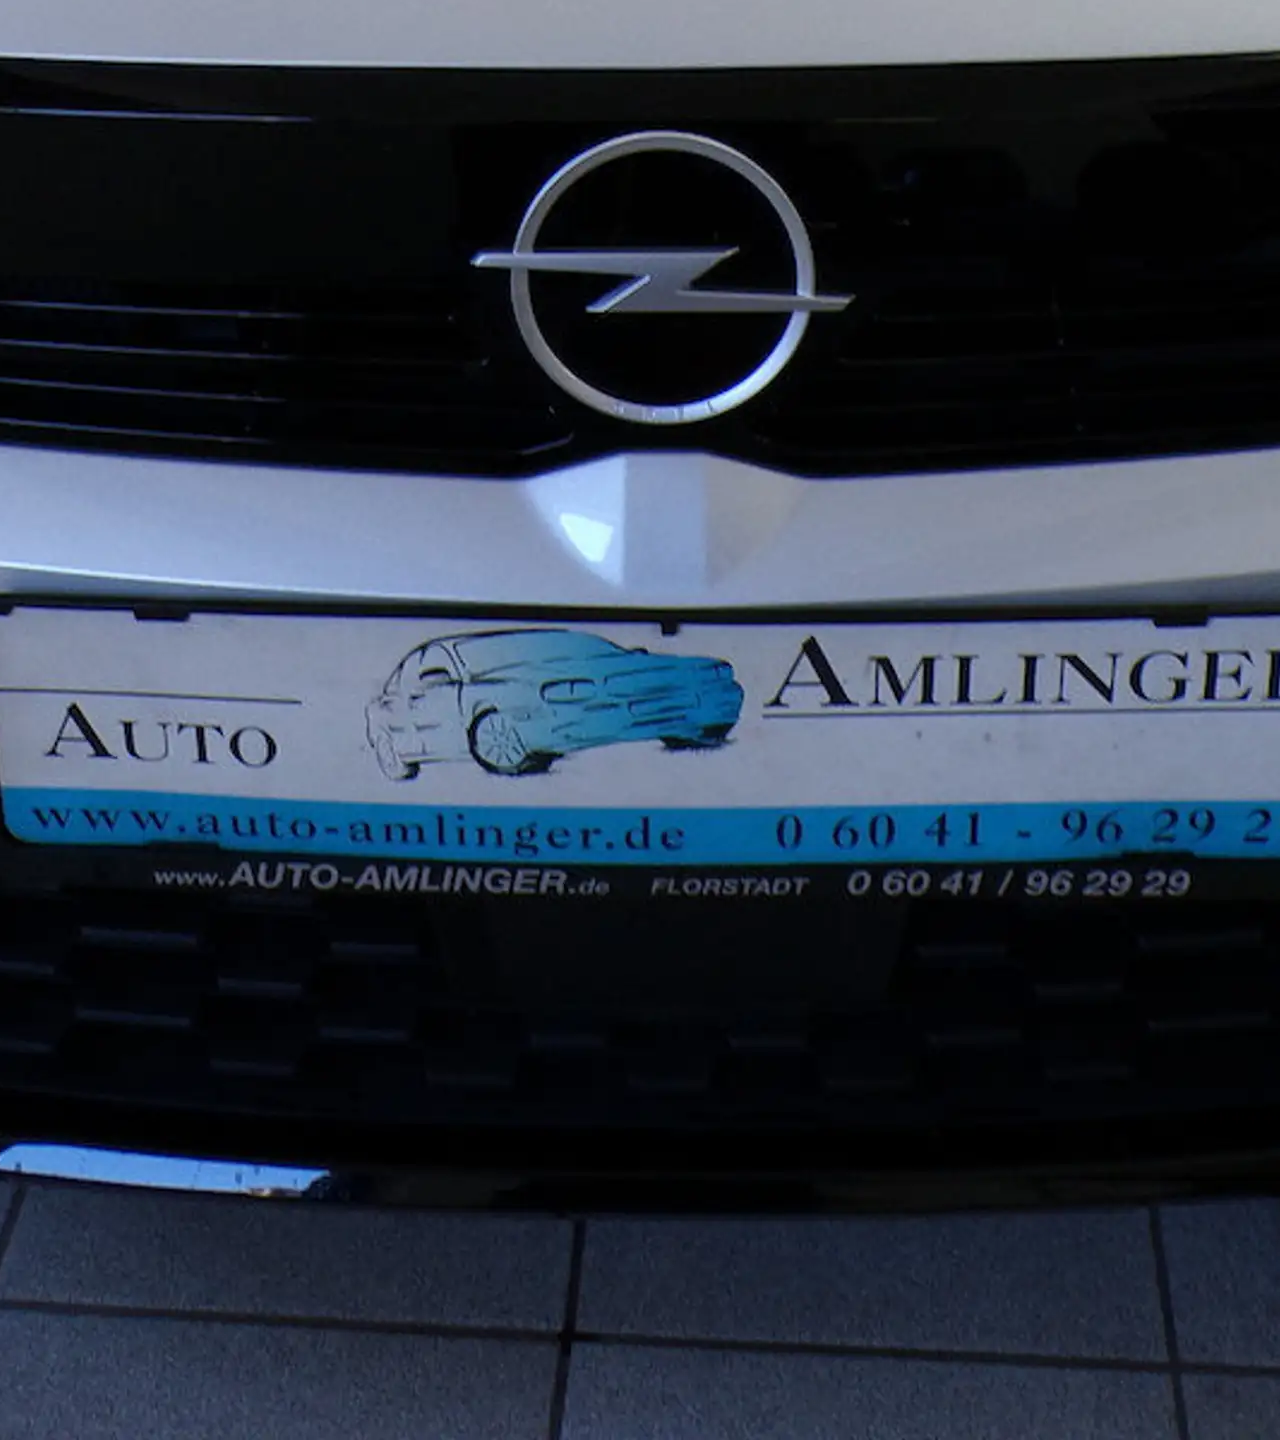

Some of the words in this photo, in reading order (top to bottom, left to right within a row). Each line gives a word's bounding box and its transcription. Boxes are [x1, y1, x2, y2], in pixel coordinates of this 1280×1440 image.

[31, 806, 686, 858] www.auto-amlinger.de
[776, 813, 803, 850] 0
[831, 812, 896, 850] 60
[923, 811, 982, 848] 41
[1061, 808, 1124, 845] 96
[1151, 807, 1216, 844] 29
[153, 861, 610, 896] www.AUTO-AMLINGER.de
[651, 876, 811, 897] FLORSTADT
[847, 869, 872, 897] 0
[882, 869, 931, 897] 60
[940, 869, 983, 897] 41
[997, 868, 1014, 897] /
[1024, 869, 1074, 897] 96
[1082, 869, 1132, 897] 29
[1141, 869, 1192, 897] 29
